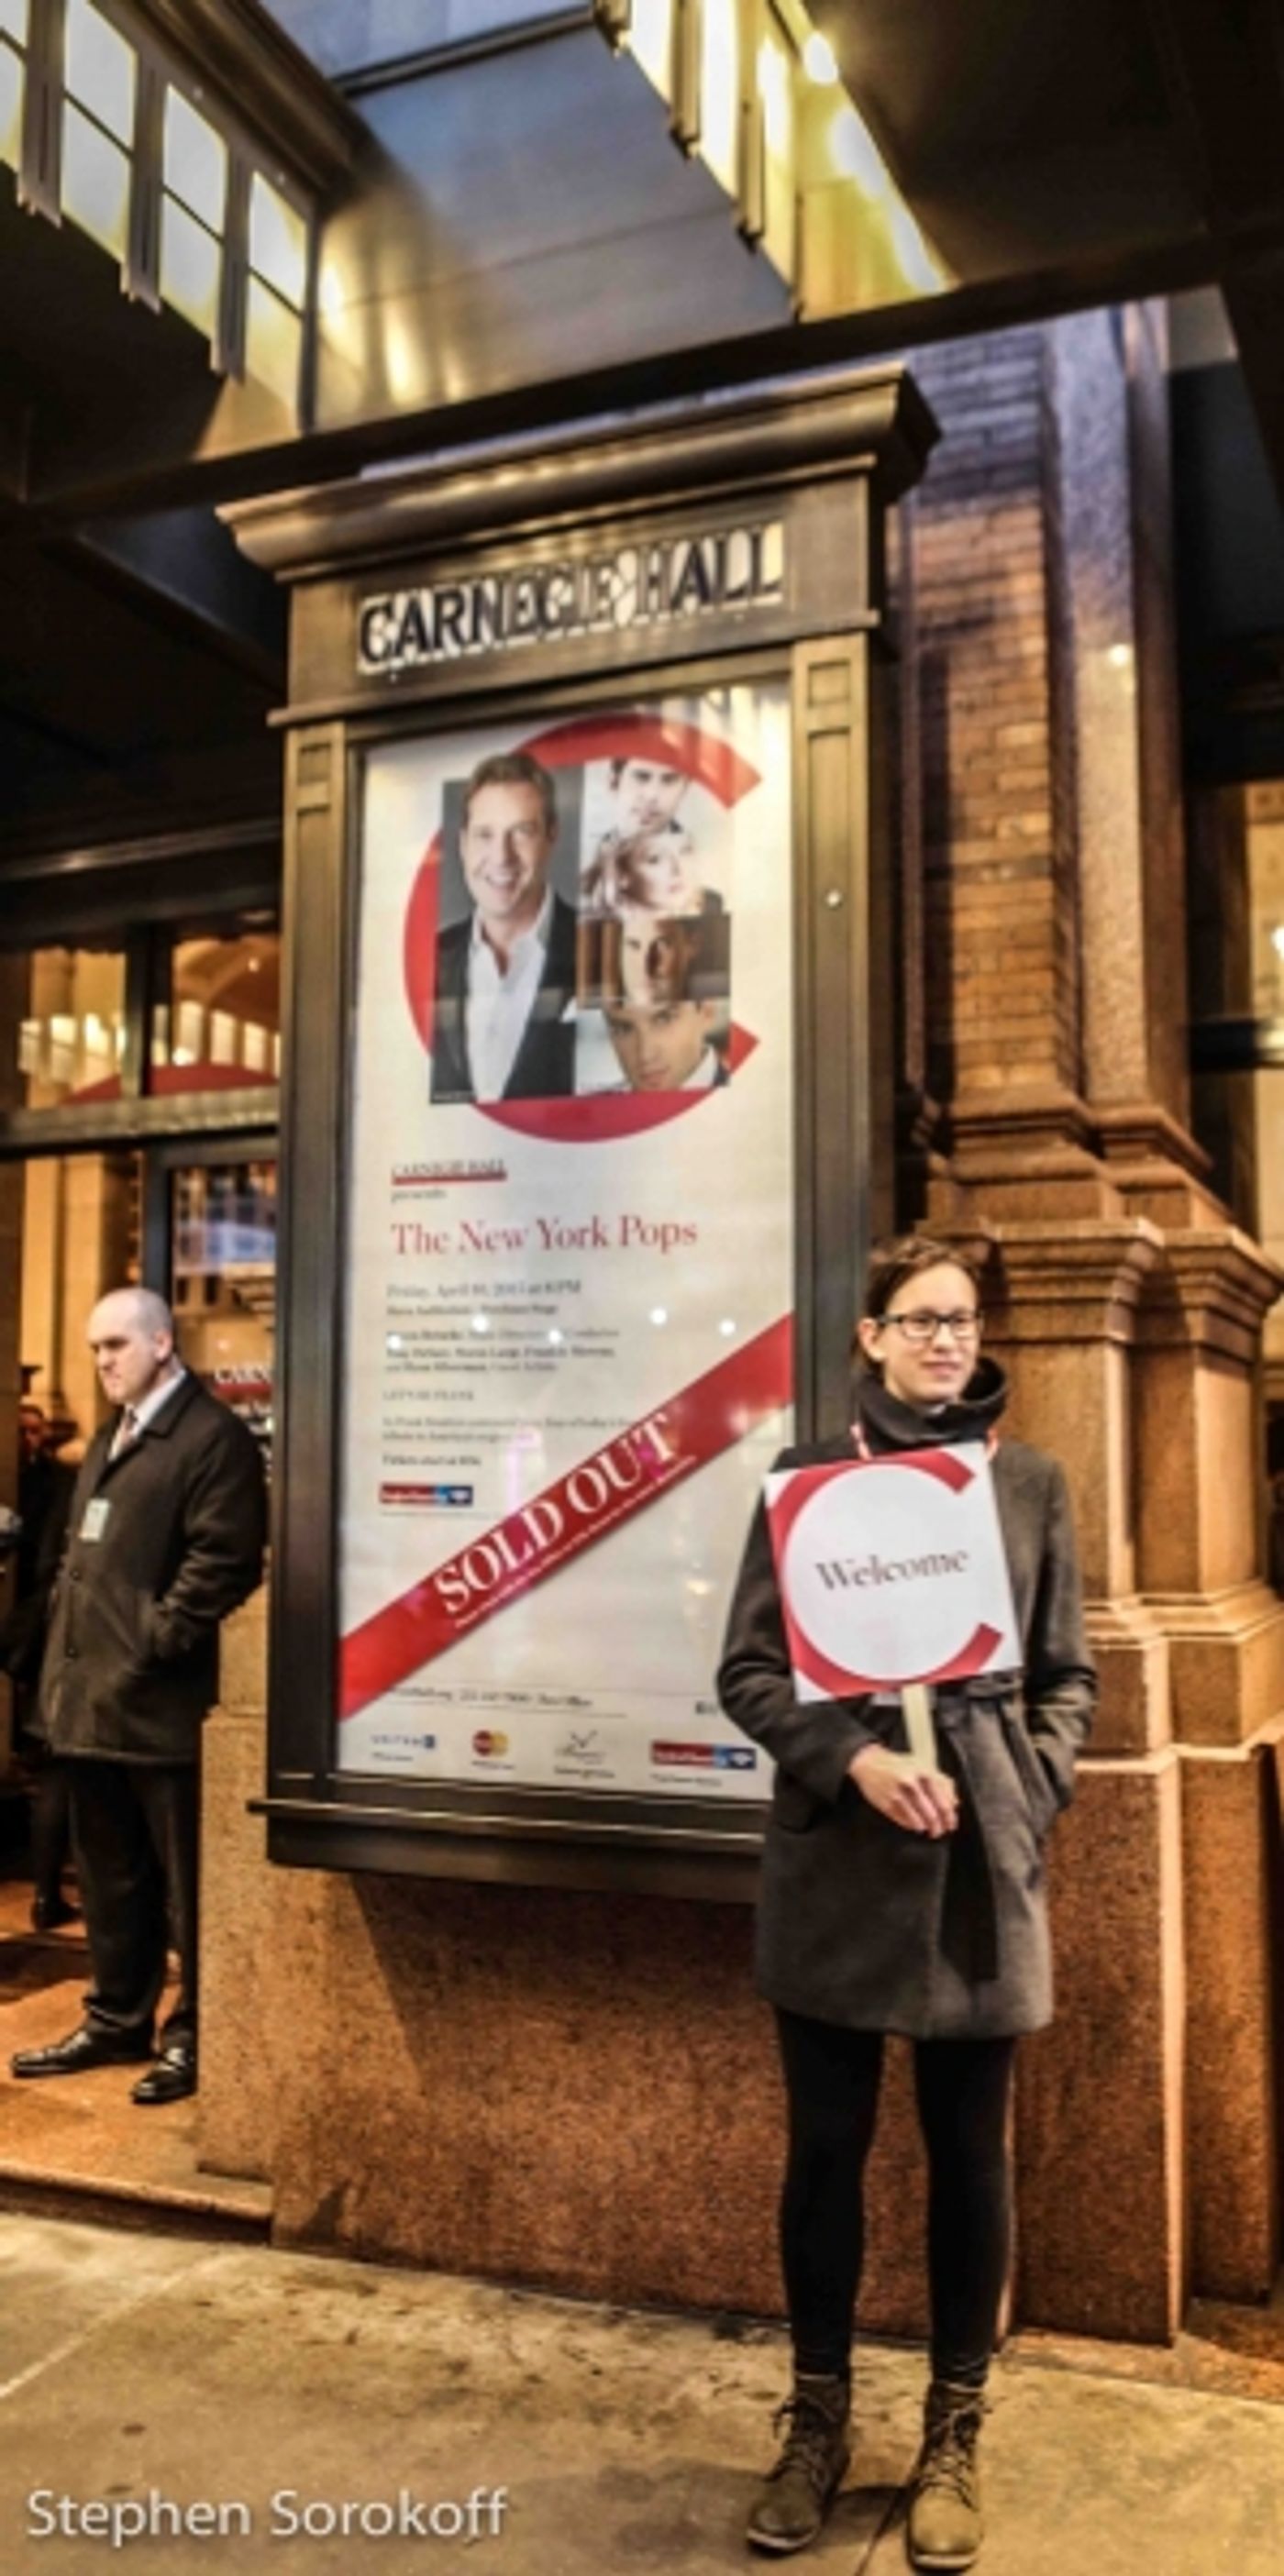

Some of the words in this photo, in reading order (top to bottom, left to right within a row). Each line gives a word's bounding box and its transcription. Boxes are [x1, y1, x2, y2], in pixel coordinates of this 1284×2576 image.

[360, 561, 618, 663] CARNEGIE
[635, 525, 783, 616] HALL
[391, 1222, 449, 1255] The
[459, 1219, 528, 1254] New
[536, 1214, 610, 1253] York
[619, 1214, 698, 1255] Pops
[434, 1498, 564, 1612] SOLD
[565, 1413, 679, 1514] OUT
[814, 1550, 969, 1591] Welcome
